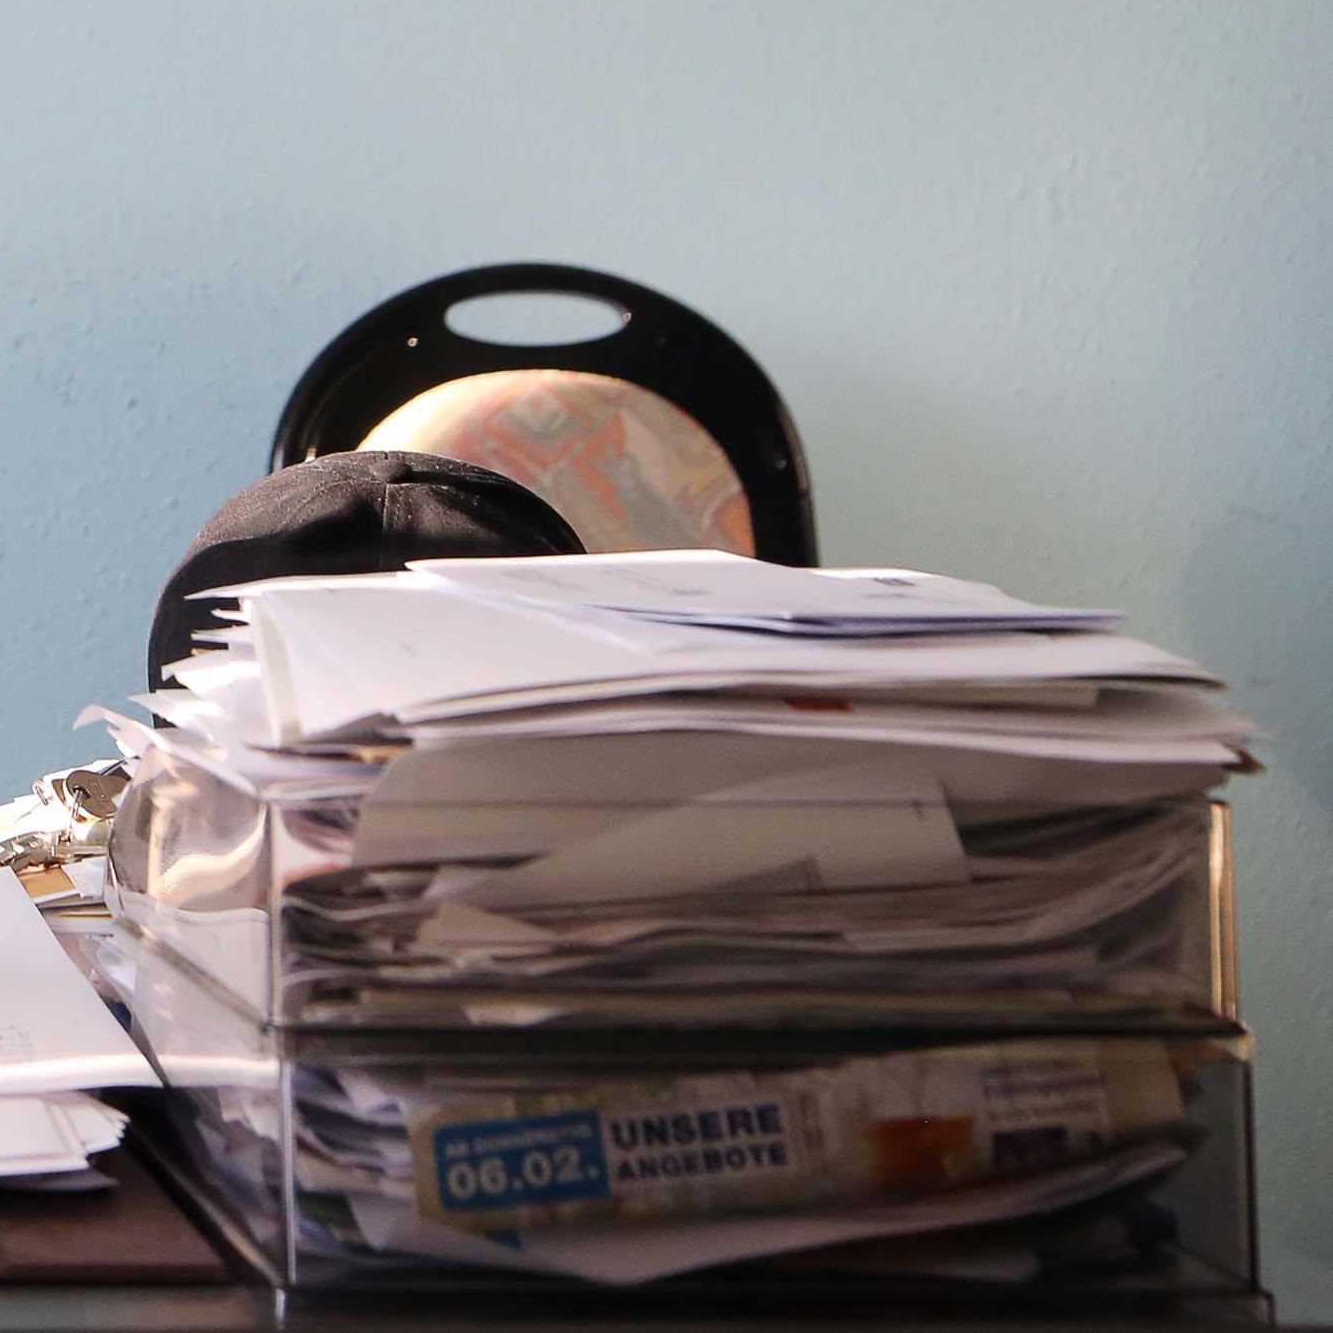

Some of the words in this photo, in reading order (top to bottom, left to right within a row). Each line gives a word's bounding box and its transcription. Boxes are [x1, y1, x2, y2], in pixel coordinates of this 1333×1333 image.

[610, 1103, 785, 1151] UNSERE
[446, 1144, 600, 1199] 06.02.
[615, 1142, 790, 1182] ANGEBOTE
